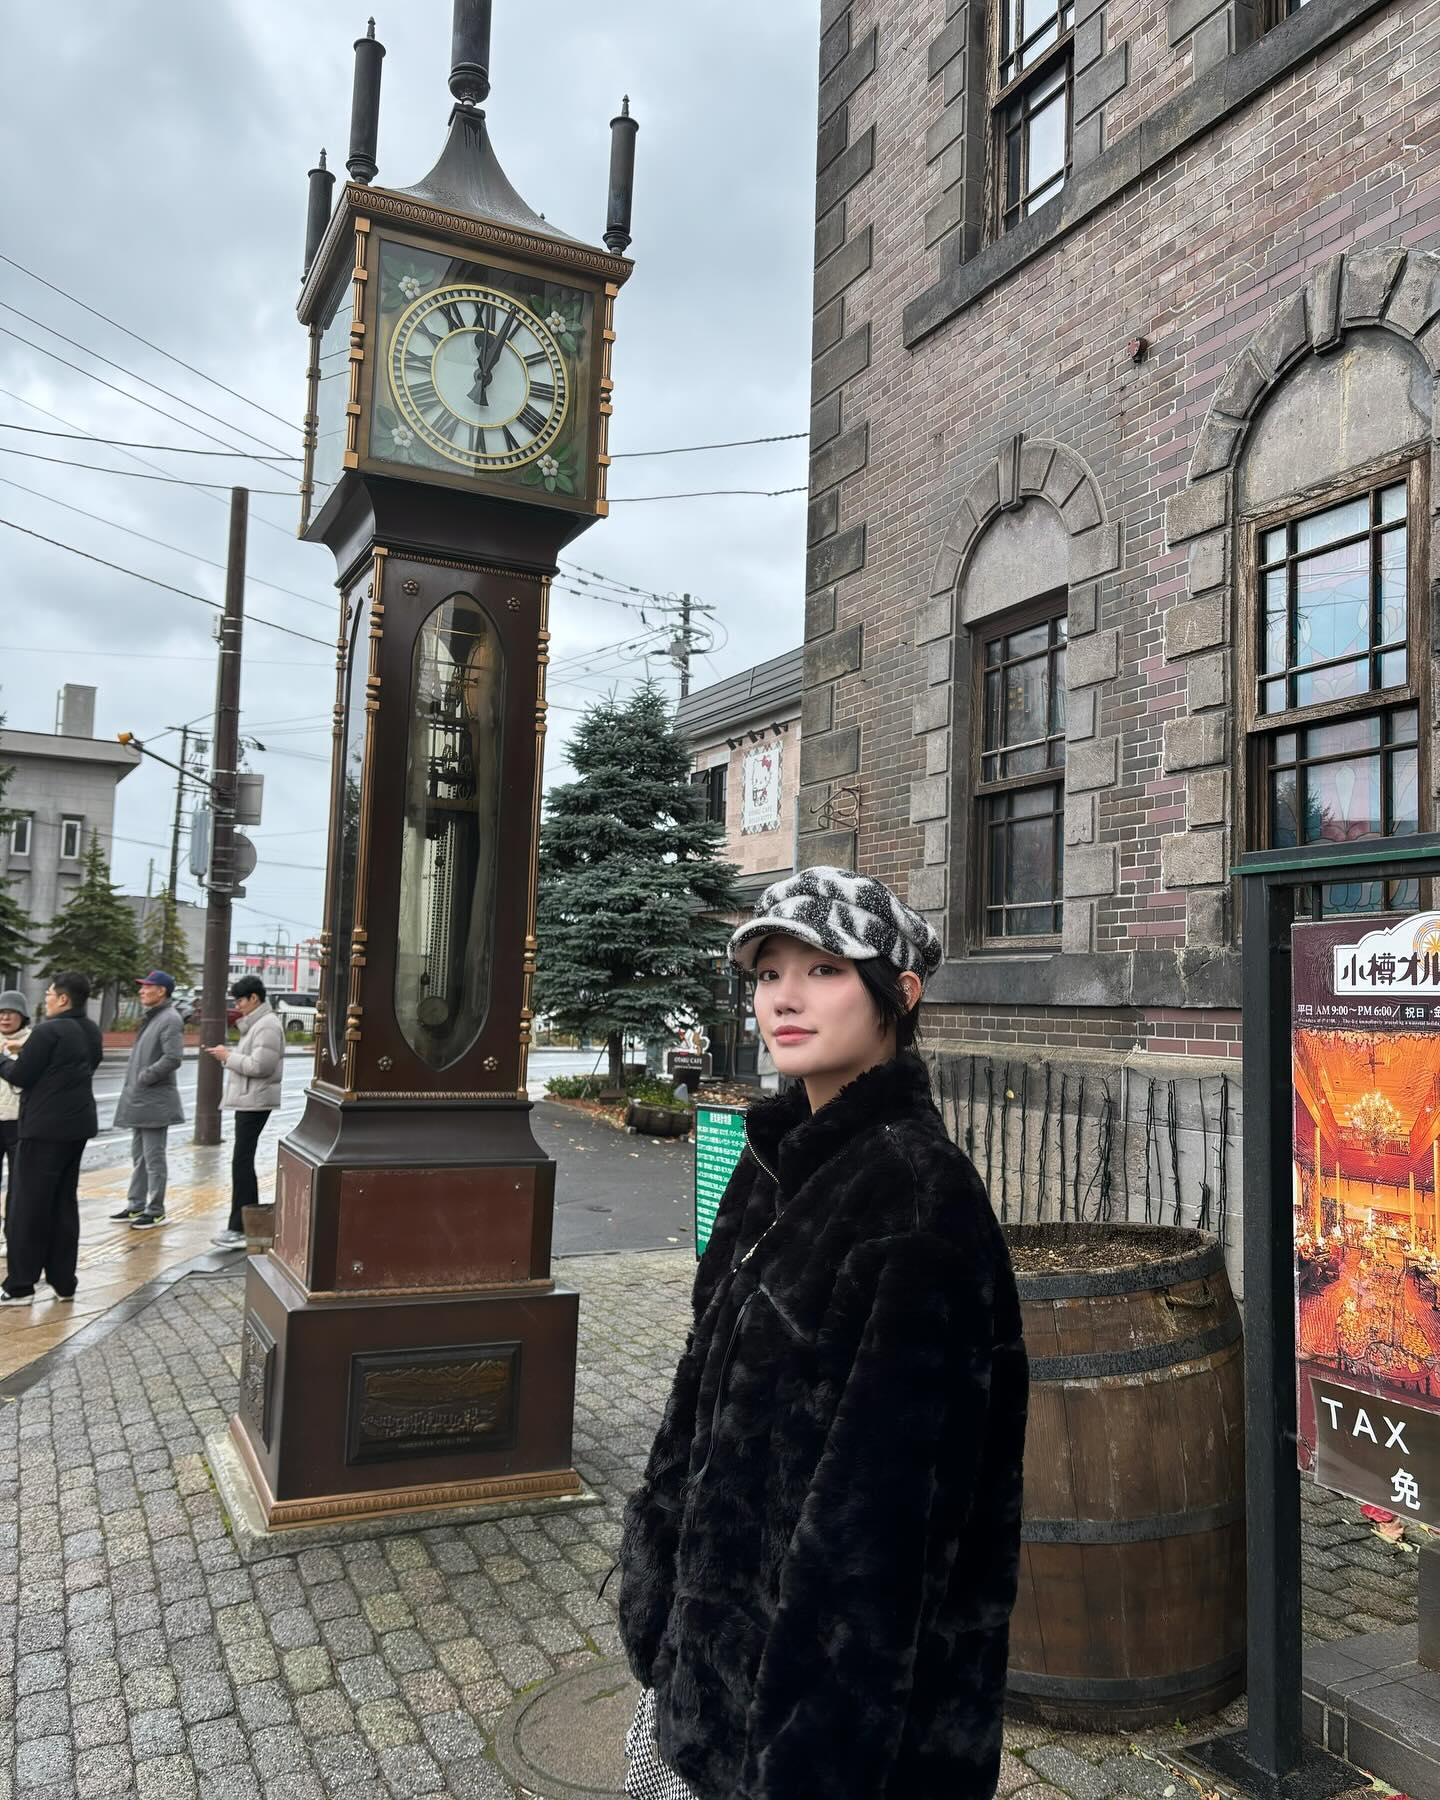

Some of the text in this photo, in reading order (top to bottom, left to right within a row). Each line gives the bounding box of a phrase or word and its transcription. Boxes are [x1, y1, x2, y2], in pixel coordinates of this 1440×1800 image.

[529, 381, 555, 402] III
[502, 424, 521, 453] V
[1297, 1004, 1313, 1016] 平日
[1315, 1005, 1330, 1015] AM
[1404, 1006, 1425, 1019] 祝日
[1320, 1396, 1410, 1455] TAX
[1391, 1467, 1421, 1510] 免
